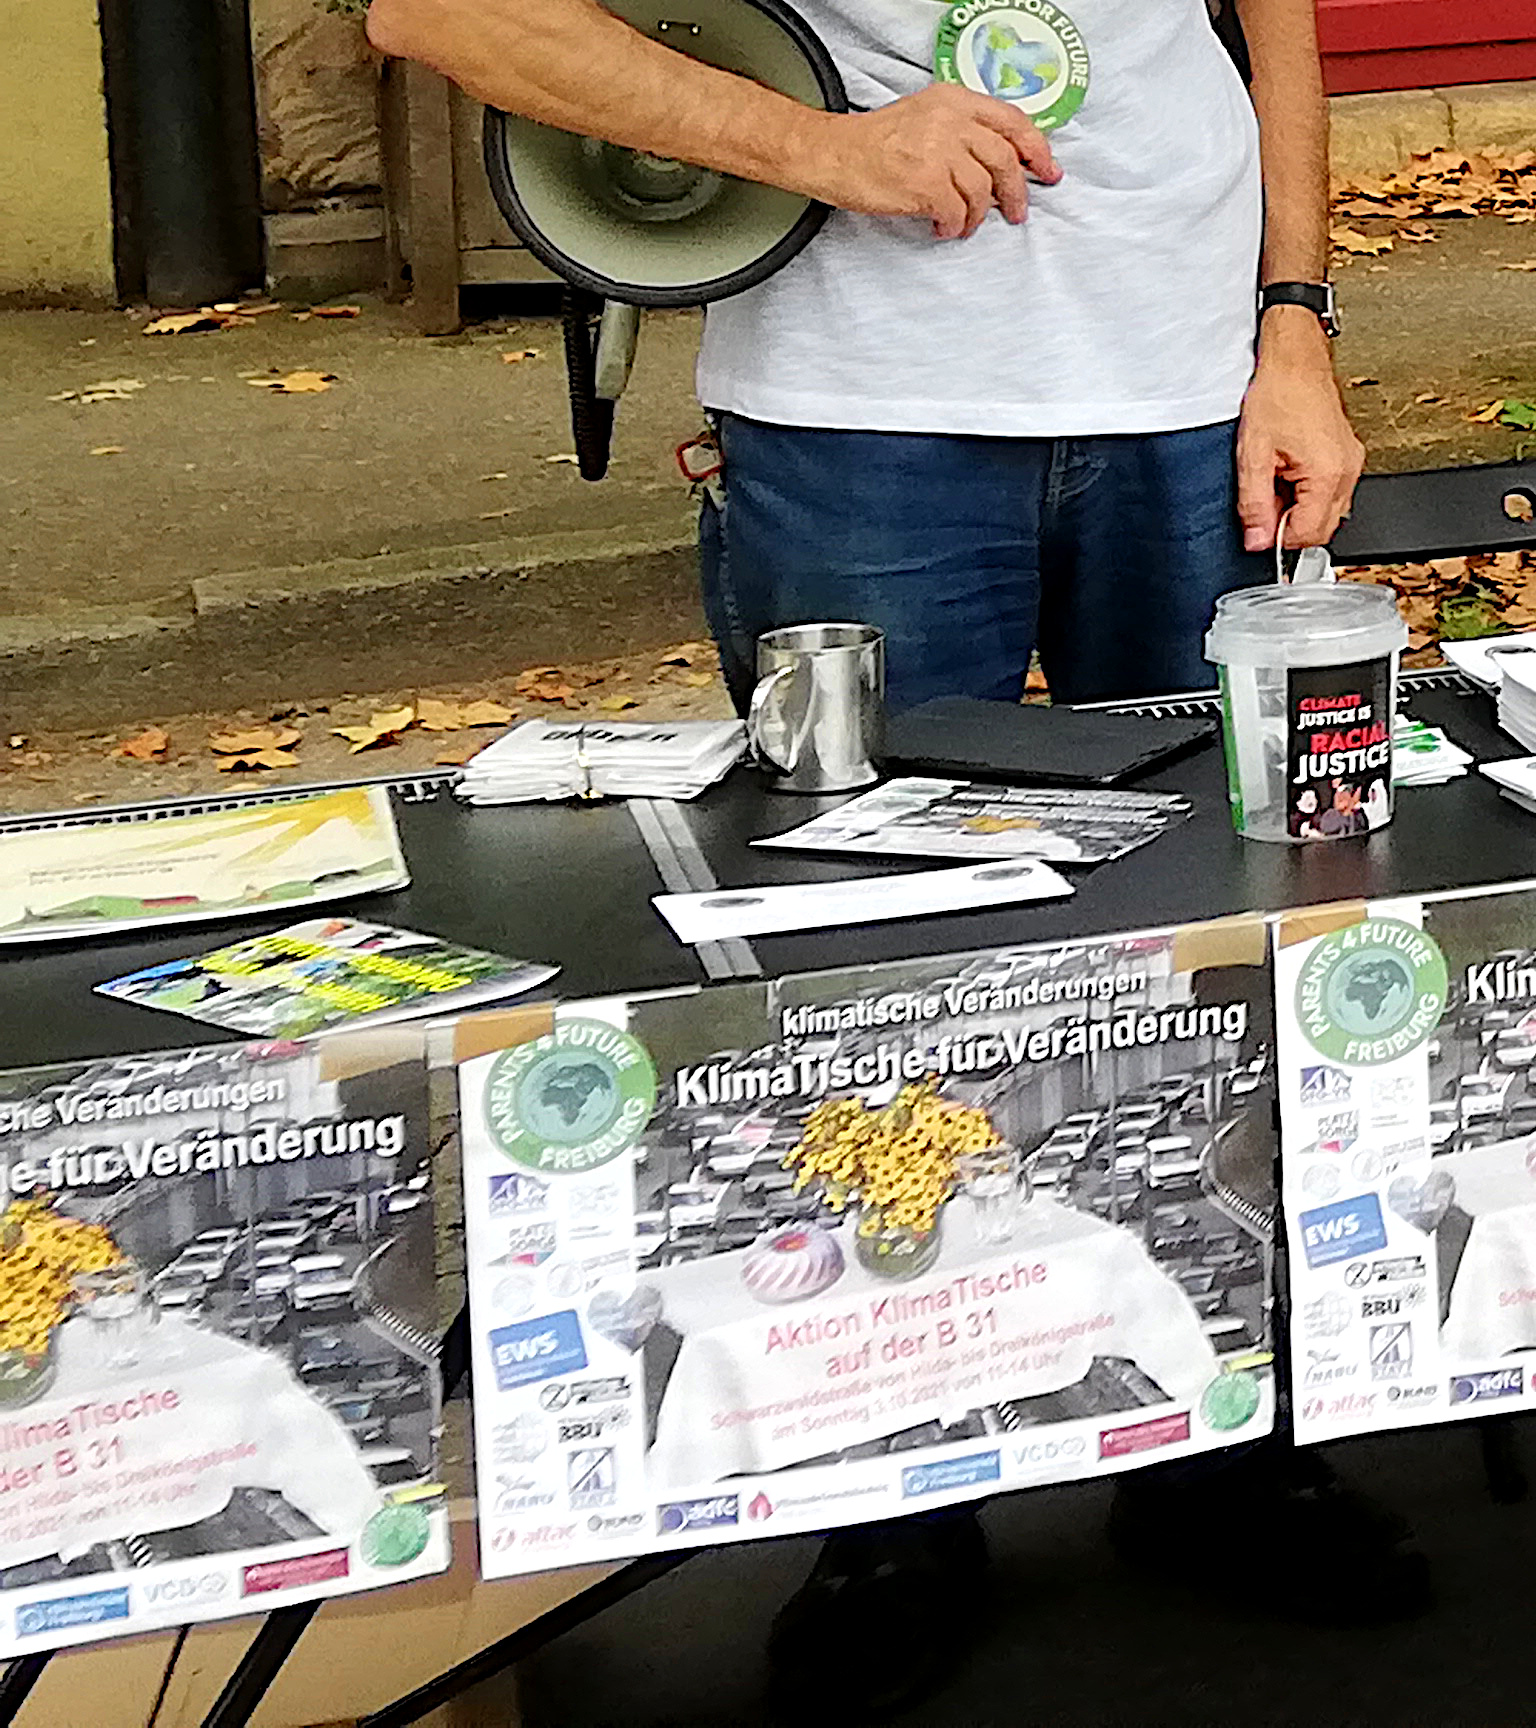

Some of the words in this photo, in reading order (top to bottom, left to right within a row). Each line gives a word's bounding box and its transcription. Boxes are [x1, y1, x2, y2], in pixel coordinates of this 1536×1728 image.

[1051, 17, 1089, 88] FUTURE
[1296, 707, 1356, 731] JUSTICE
[1357, 705, 1372, 721] IS
[1298, 693, 1362, 712] CLIMATE
[1293, 740, 1390, 784] JUSTICE
[1310, 720, 1391, 755] RACIAL
[781, 991, 940, 1037] klimatische
[944, 969, 1148, 1020] Veränderungen
[1302, 942, 1341, 1039] PARENTS
[1360, 922, 1433, 968] FUTURE
[675, 1036, 926, 1109] KlimaTische
[1001, 1000, 1249, 1064] Veränderung
[1343, 992, 1440, 1062] FREIBURG
[490, 1044, 537, 1144] PARENTS
[556, 1024, 641, 1071] FUTURE
[120, 1113, 405, 1179] Veränderung
[539, 1096, 647, 1169] FREIBURG
[1305, 1213, 1361, 1247] EWS
[765, 1310, 862, 1356] Aktion
[869, 1260, 1050, 1330] KlimaTische
[825, 1346, 873, 1378] auf
[882, 1329, 930, 1365] der
[935, 1318, 959, 1349] B
[966, 1307, 1000, 1340] 31
[495, 1330, 558, 1366] EWS
